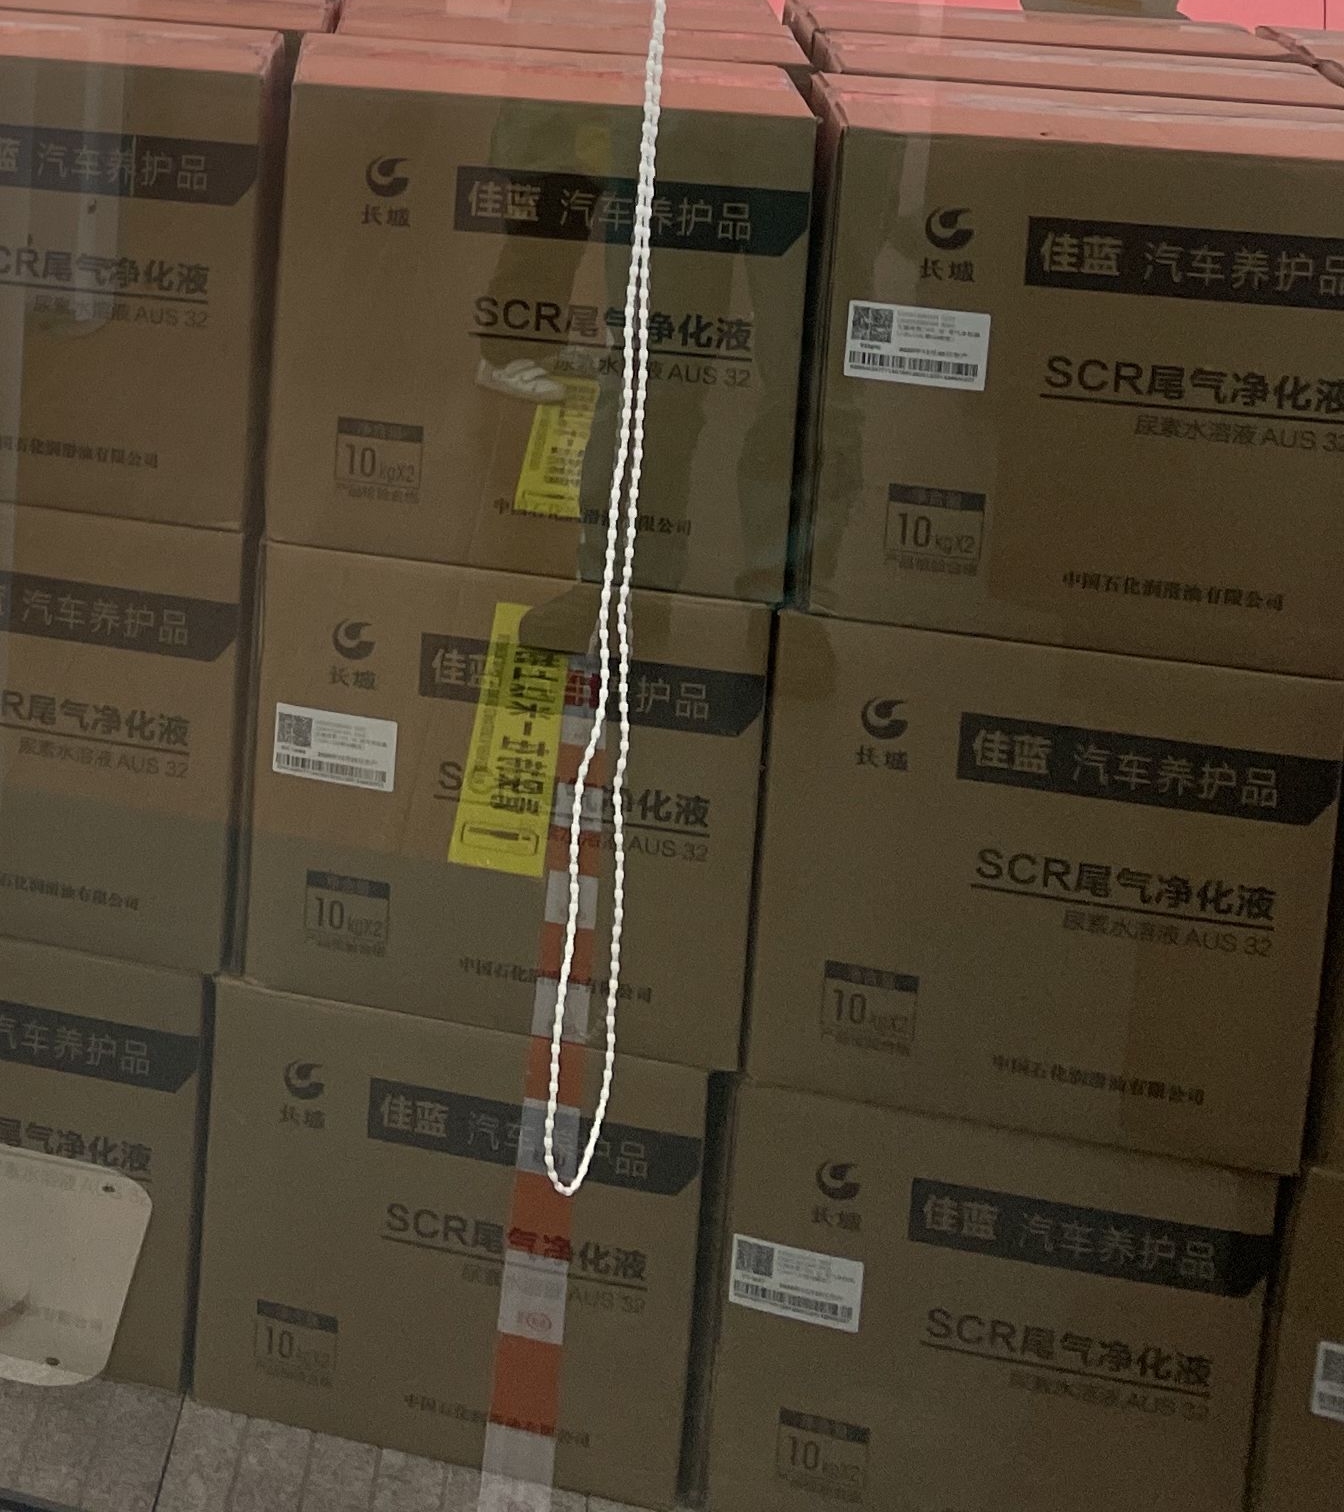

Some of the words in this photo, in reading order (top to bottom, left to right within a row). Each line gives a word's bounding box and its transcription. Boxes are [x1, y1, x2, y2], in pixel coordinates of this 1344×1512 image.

[468, 180, 541, 222] 佳蓝
[1041, 231, 1124, 277] 佳蓝
[667, 363, 717, 387] AUS
[724, 366, 751, 388] 32
[345, 443, 376, 479] 10
[897, 511, 932, 548] 10
[972, 728, 1053, 776] 佳蓝
[315, 896, 345, 931] 10
[831, 987, 867, 1026] 10
[786, 1434, 821, 1473] 10
